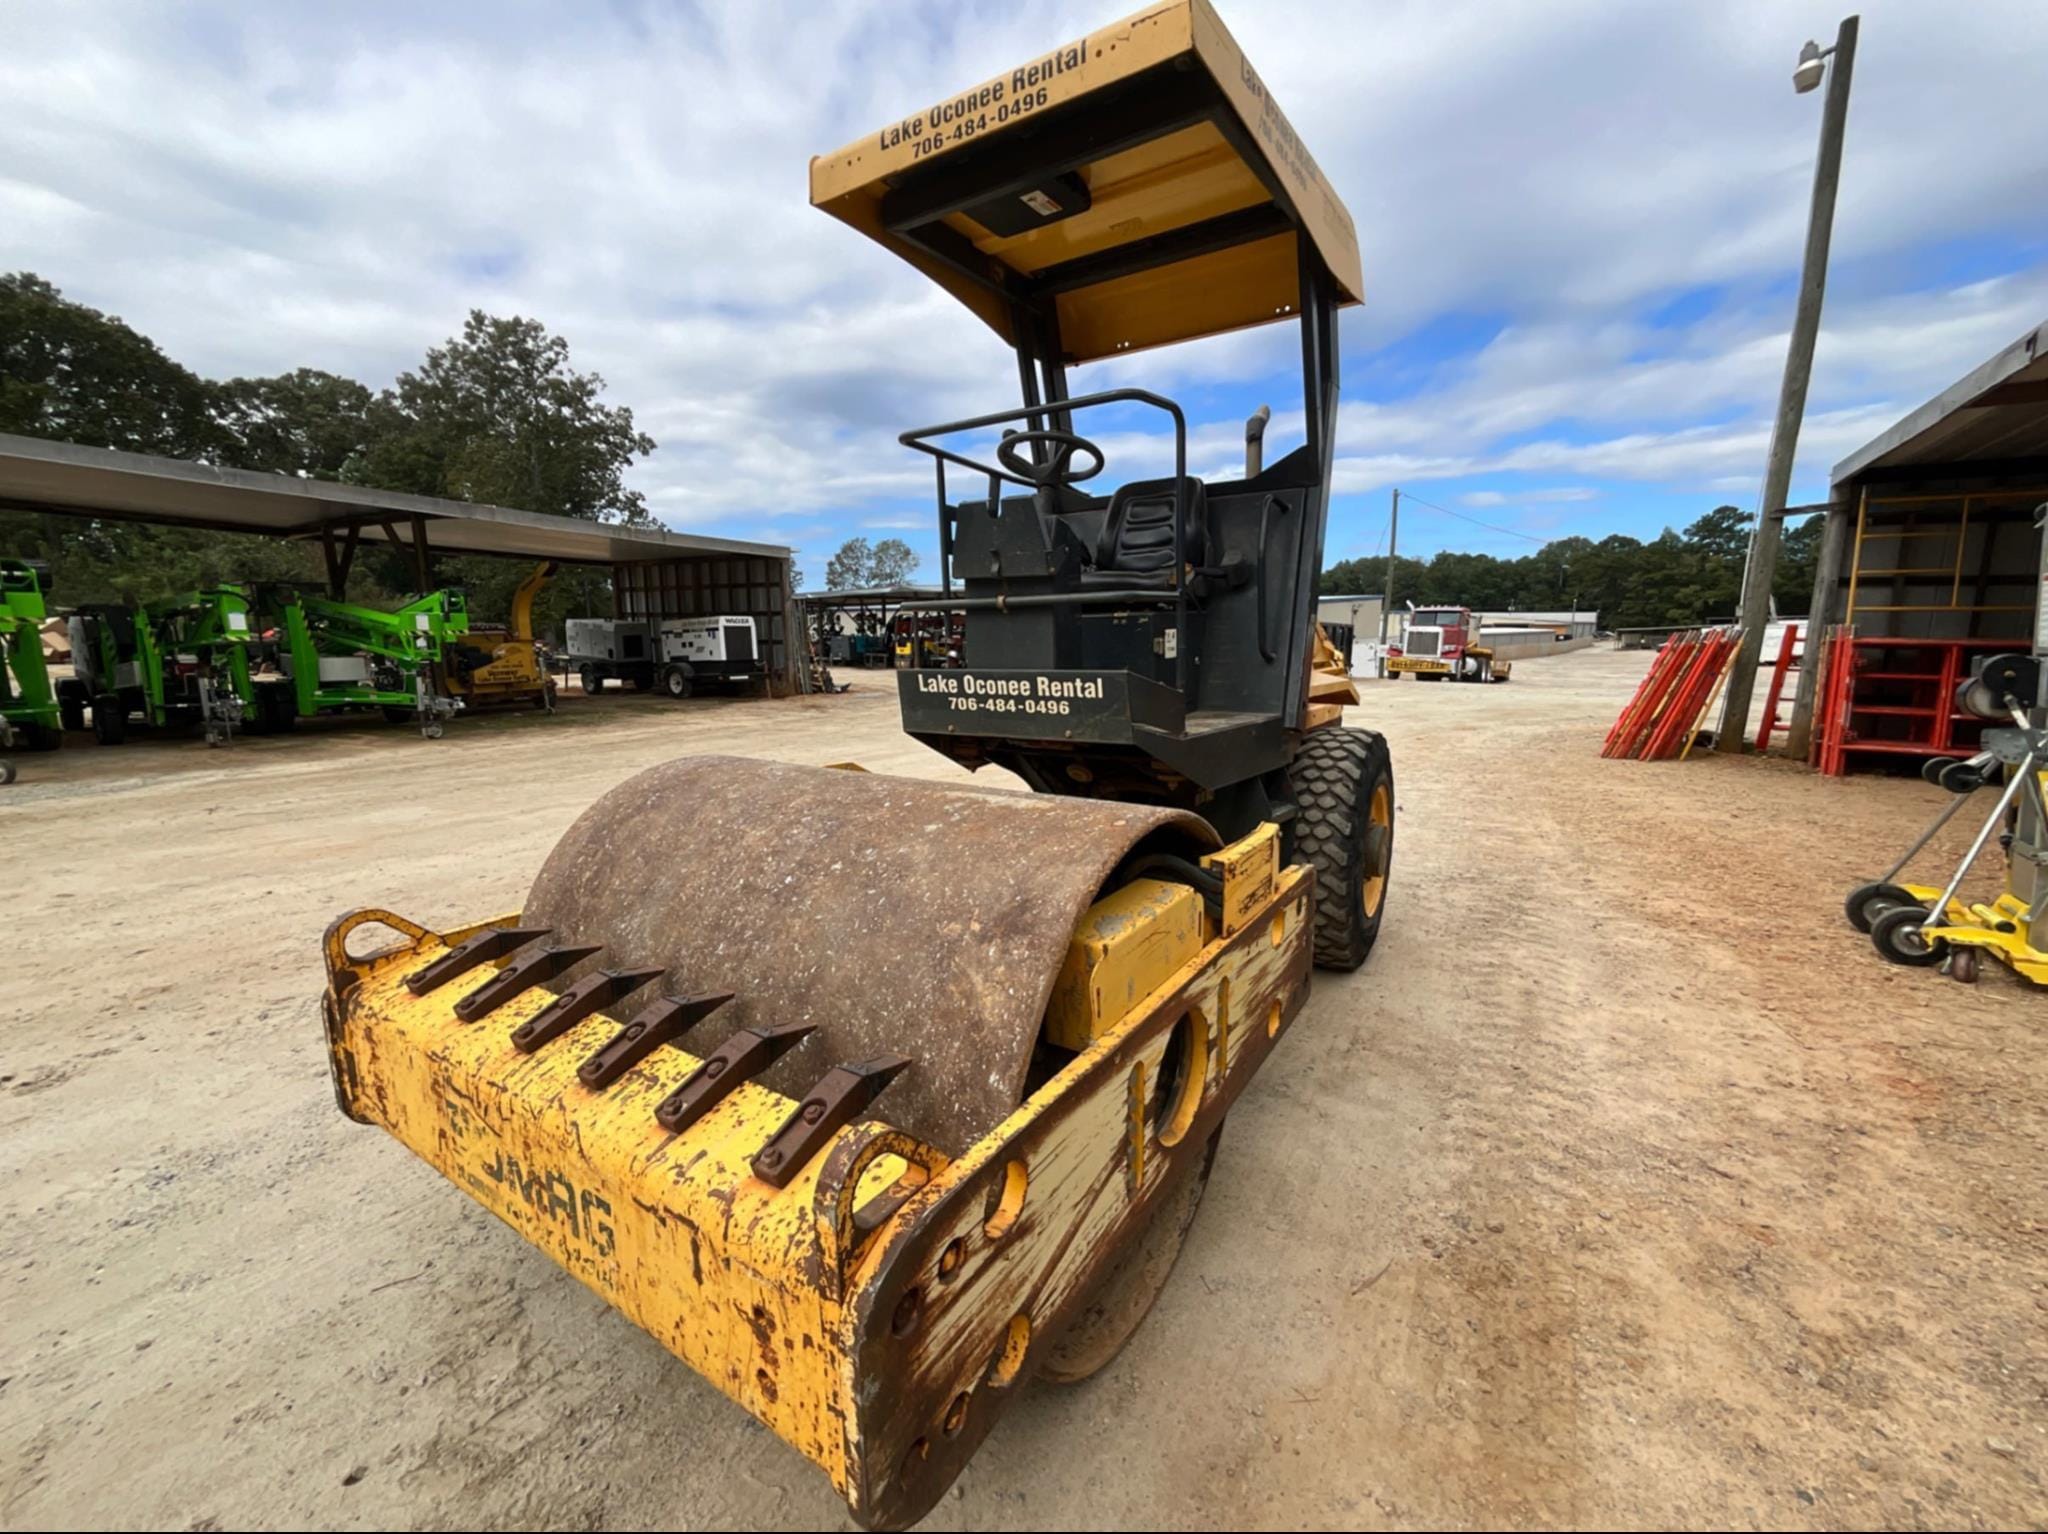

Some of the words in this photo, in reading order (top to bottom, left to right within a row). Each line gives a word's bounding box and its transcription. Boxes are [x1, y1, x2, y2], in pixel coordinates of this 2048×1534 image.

[879, 117, 923, 151] Lake
[929, 80, 1004, 129] Oconee
[1011, 39, 1087, 93] Rental
[912, 87, 1048, 159] 706-484-0496
[917, 674, 958, 694] Lake
[963, 675, 1031, 696] Oconee
[1036, 676, 1104, 699] Rental
[948, 697, 1071, 715] 706-484-0496
